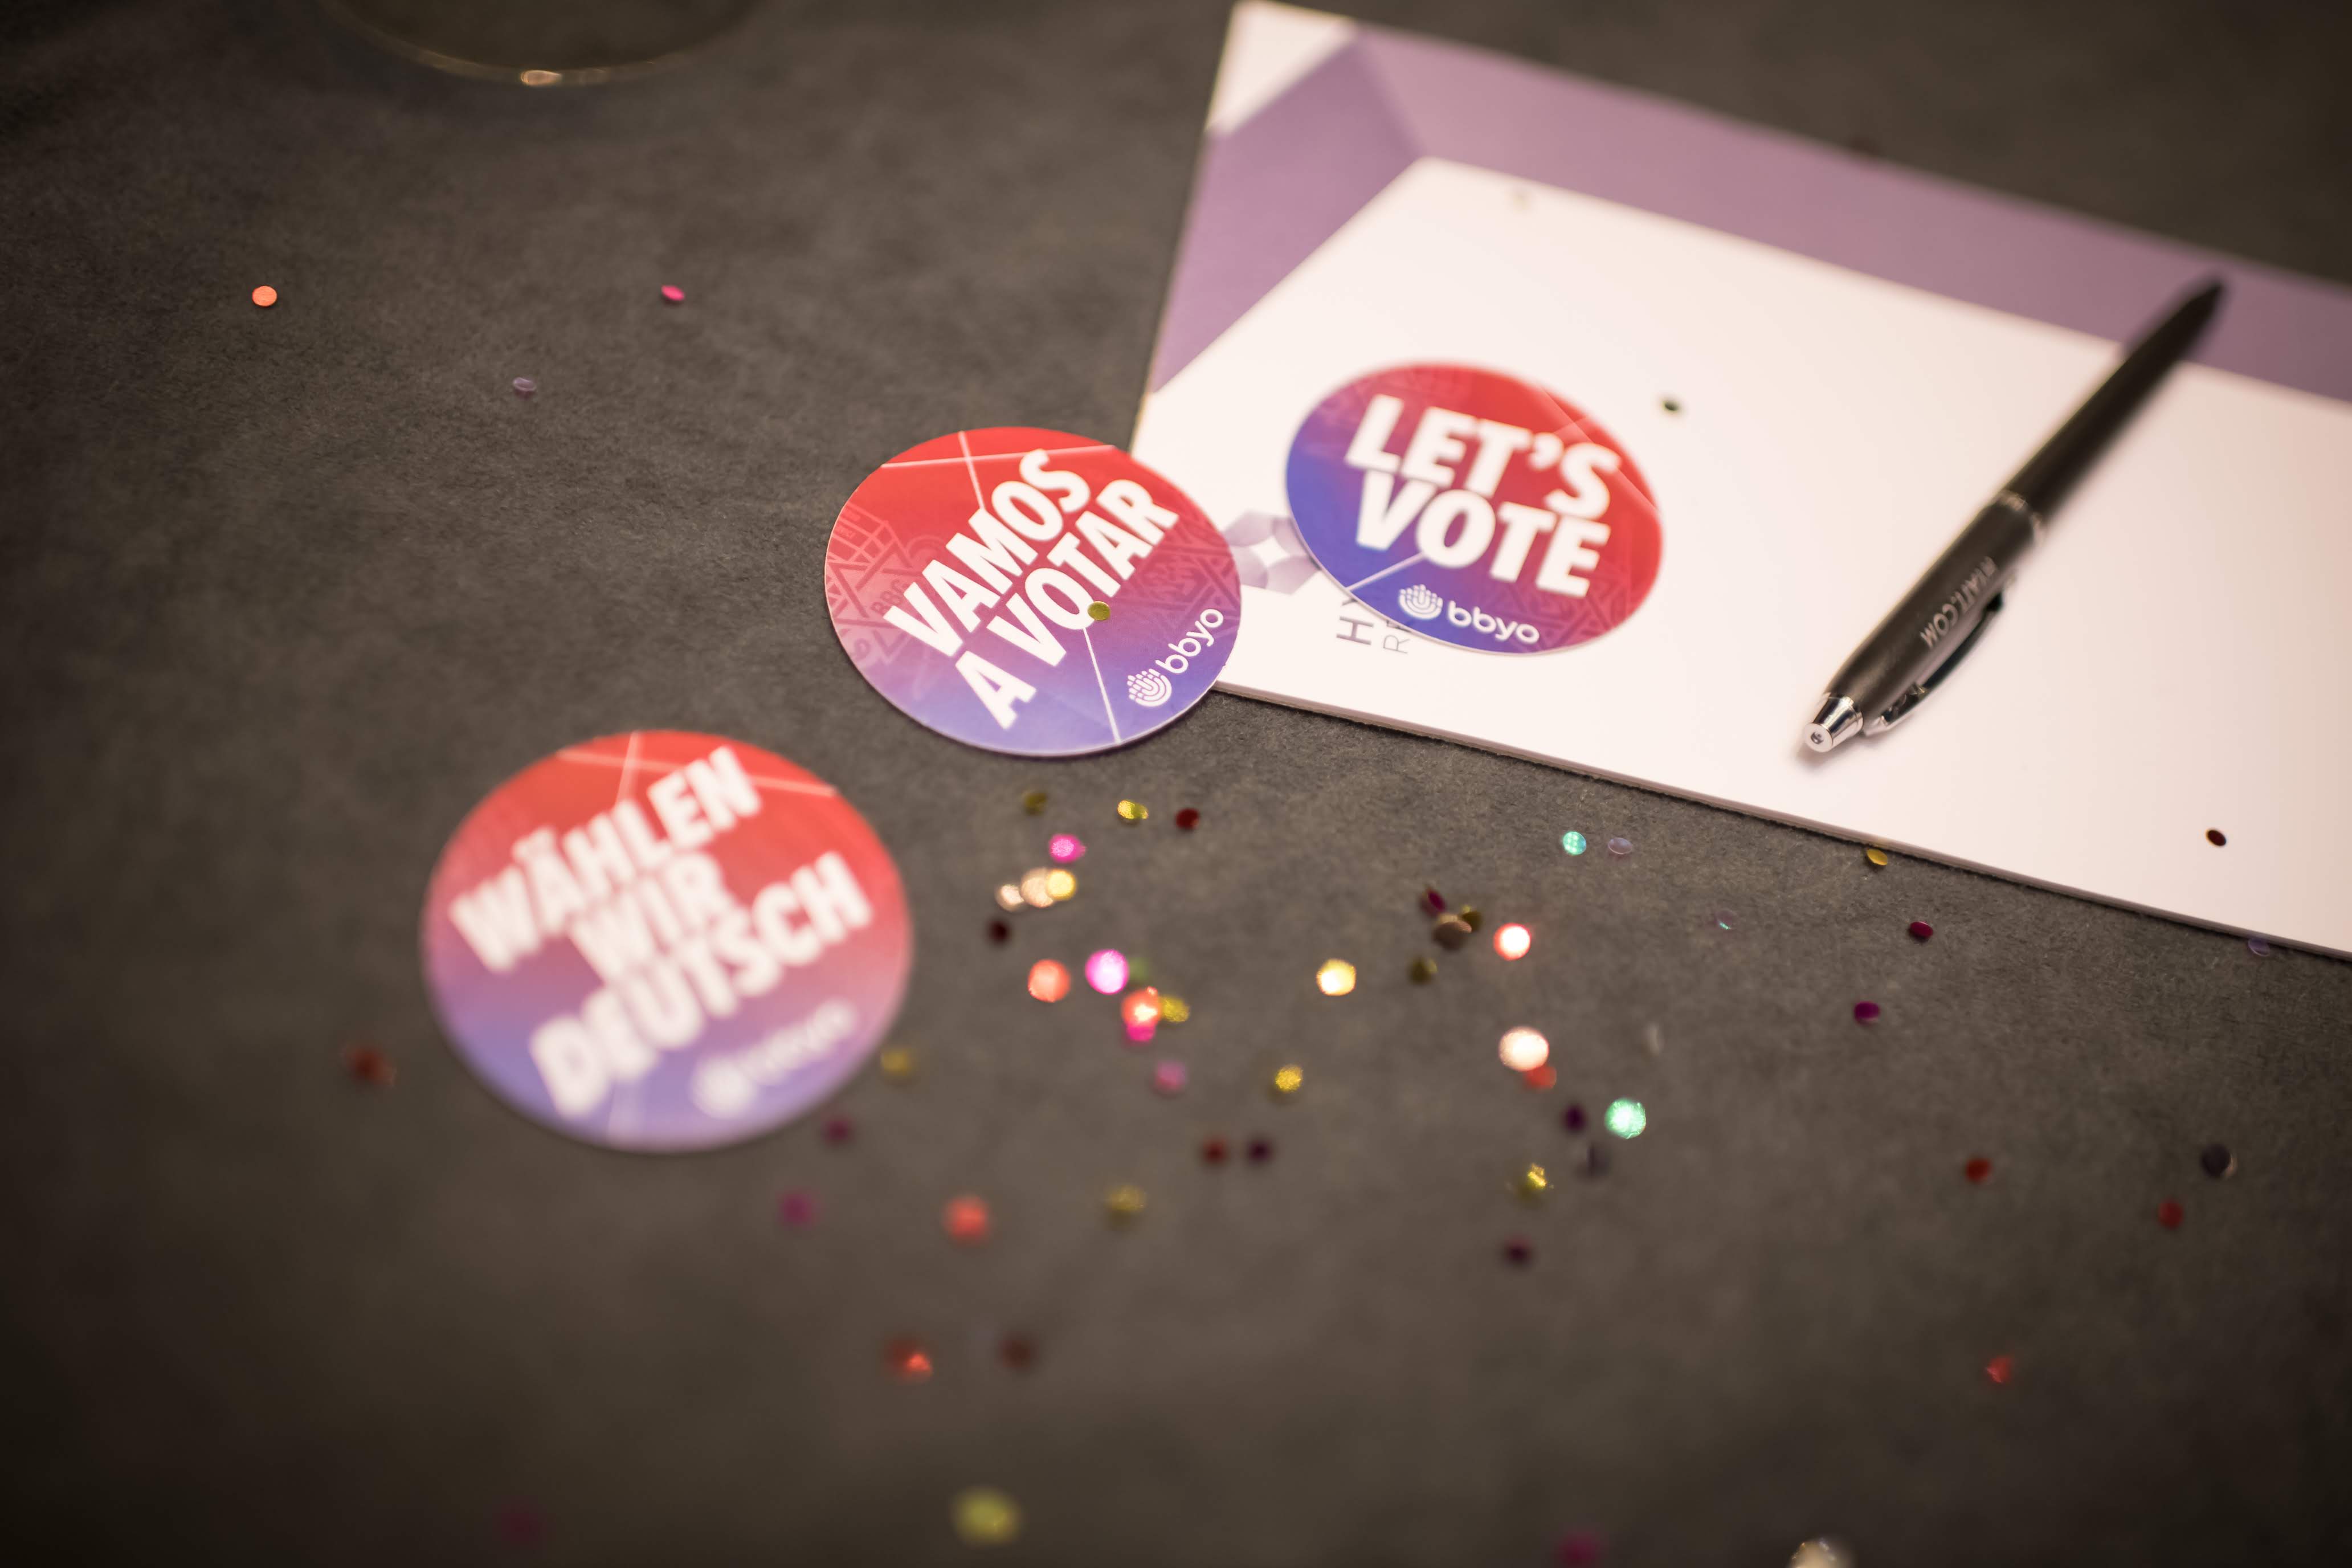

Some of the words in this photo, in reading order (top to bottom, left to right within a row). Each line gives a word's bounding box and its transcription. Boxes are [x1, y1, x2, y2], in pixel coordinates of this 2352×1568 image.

[1345, 393, 1624, 521] LET'S
[883, 448, 1091, 658] VAMOS
[986, 479, 1179, 667] VOTAR
[1356, 471, 1612, 598] VOTE
[1155, 608, 1224, 675] bbyo
[1446, 600, 1540, 644] bbyo
[955, 651, 1038, 731] A
[449, 744, 762, 973] WÄHLEN
[570, 848, 735, 989] WIR
[529, 849, 872, 1118] DEUTSCH
